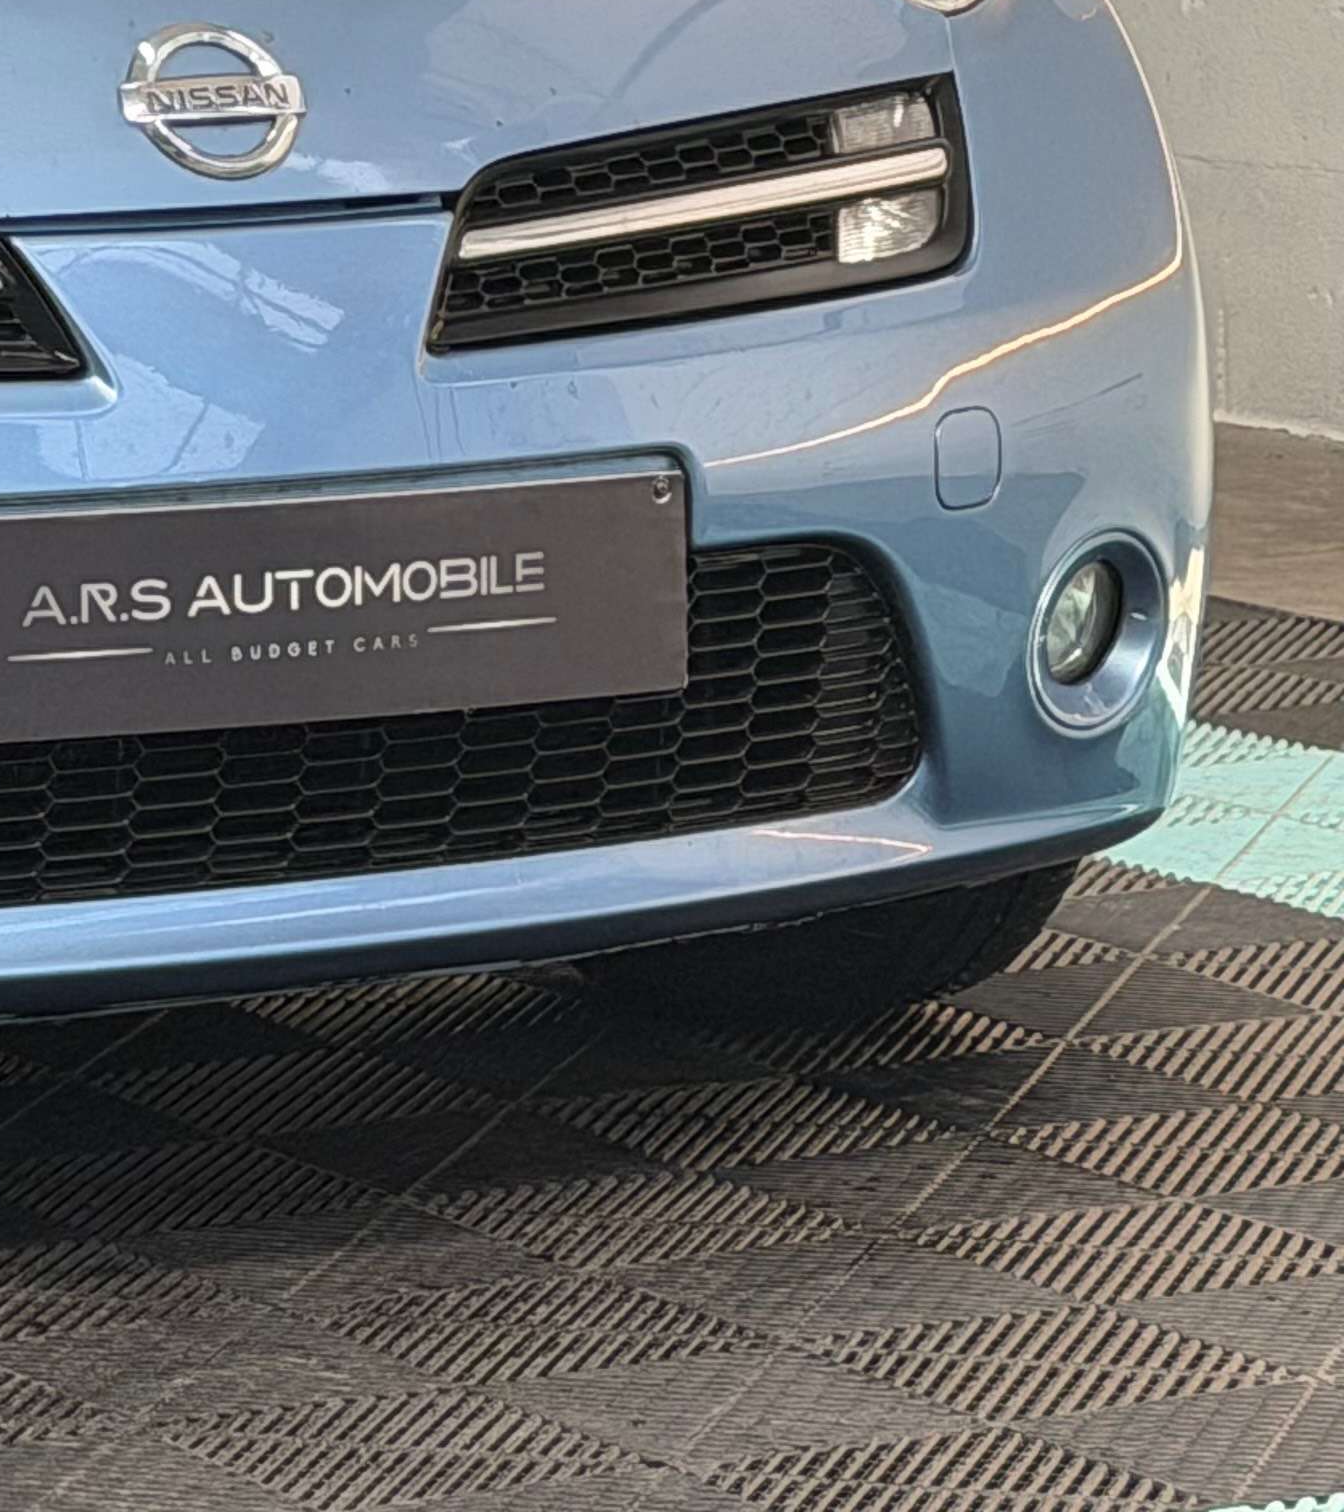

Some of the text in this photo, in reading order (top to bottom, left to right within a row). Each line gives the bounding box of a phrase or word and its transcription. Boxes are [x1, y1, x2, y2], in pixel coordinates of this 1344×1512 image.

[146, 82, 291, 114] NISSAN
[22, 551, 545, 627] A.R.S AUTOMOBILE
[164, 633, 419, 665] ALL BUDGET CARS
